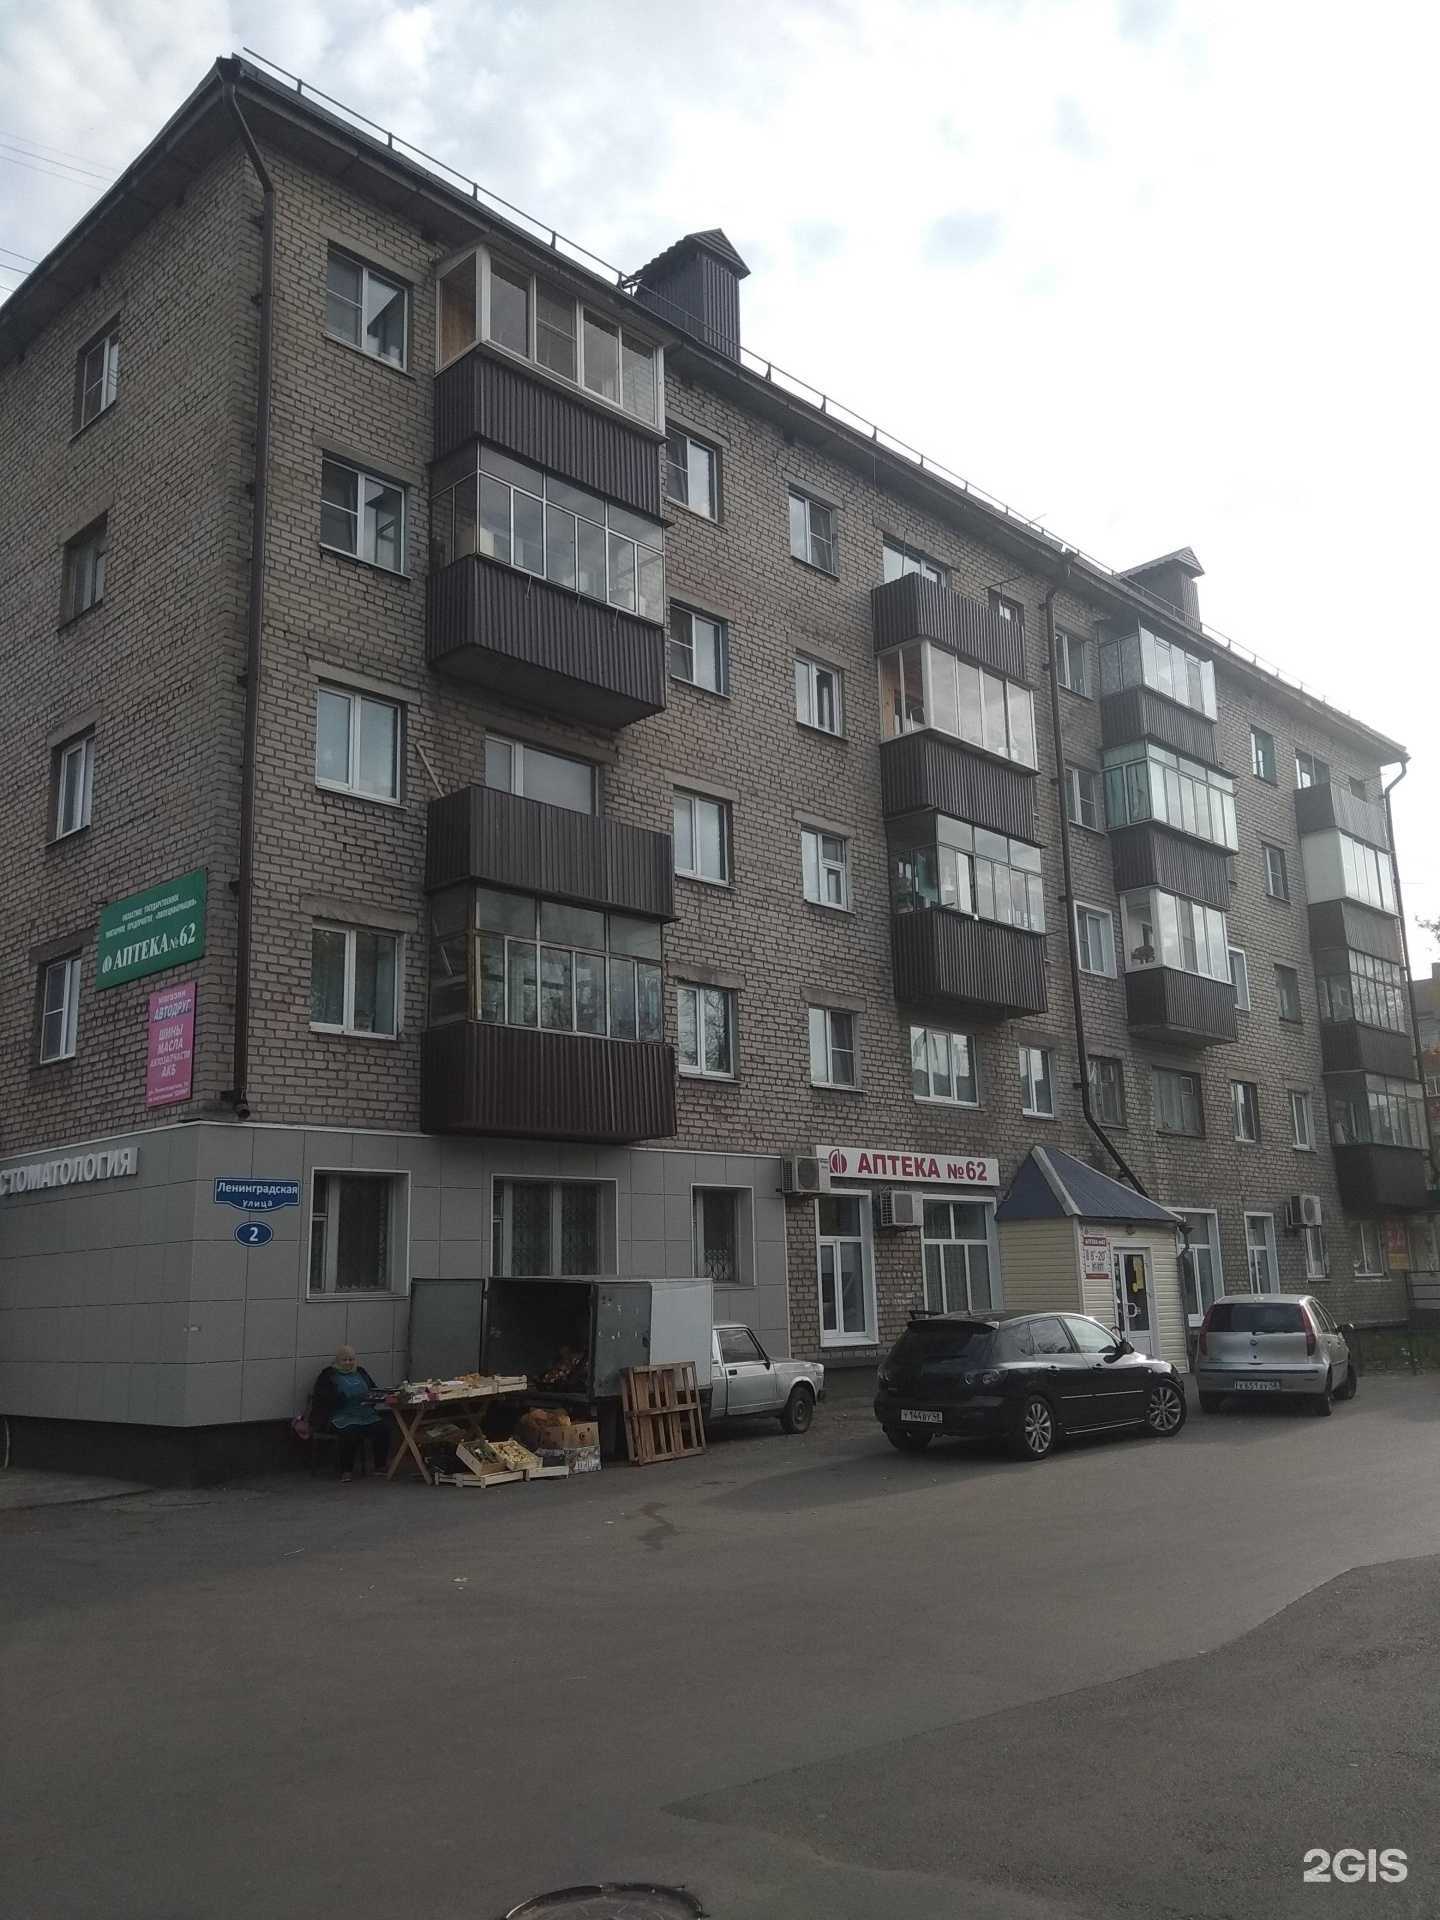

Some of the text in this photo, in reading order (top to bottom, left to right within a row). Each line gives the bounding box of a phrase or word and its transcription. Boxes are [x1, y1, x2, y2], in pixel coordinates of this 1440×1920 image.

[113, 932, 169, 970] АПТЕКА
[0, 1147, 138, 1195] СТОМАТОЛОГИЯ
[857, 1152, 941, 1179] АПТЕКА
[946, 1160, 988, 1182] №62
[217, 1182, 298, 1196] Ленинградская
[249, 1226, 259, 1242] 2
